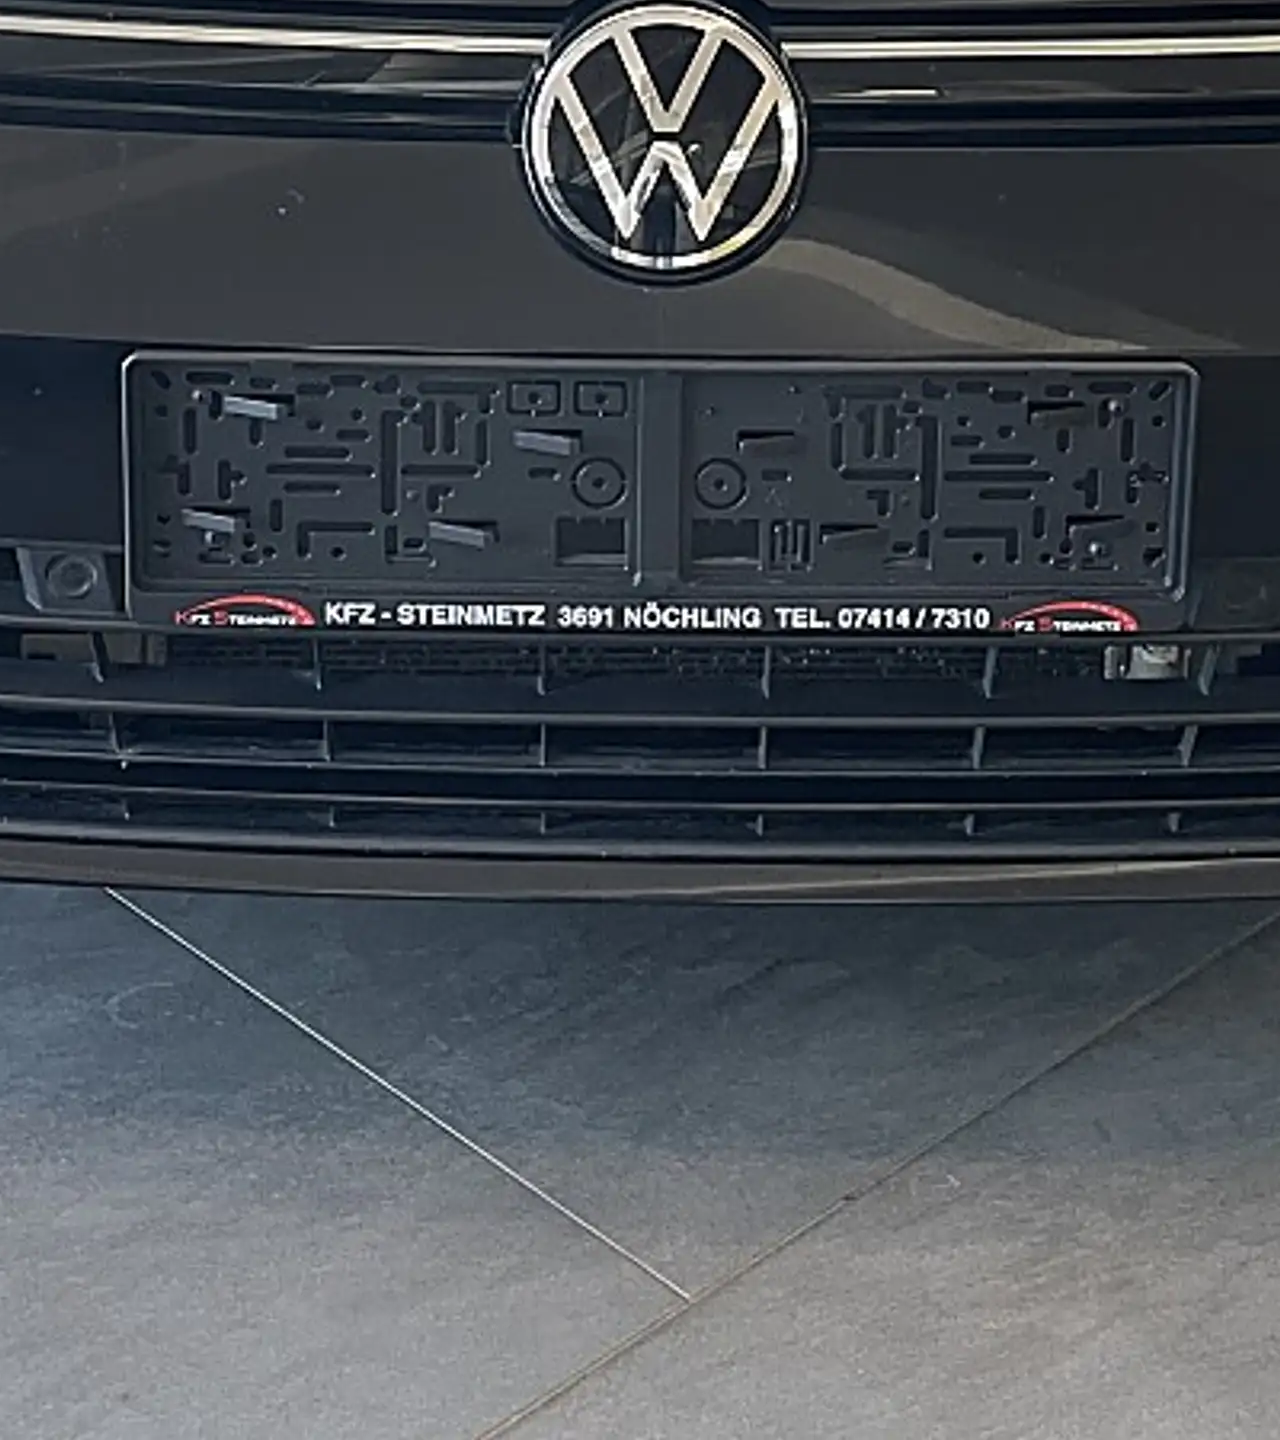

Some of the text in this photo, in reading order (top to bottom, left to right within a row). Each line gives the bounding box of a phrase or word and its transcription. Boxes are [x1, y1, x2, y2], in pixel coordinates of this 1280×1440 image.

[324, 602, 376, 626] KFZ
[396, 604, 546, 627] STEINMETZ
[557, 604, 614, 629] 3691
[623, 601, 762, 629] NÖCHLING
[774, 607, 832, 630] TEL.
